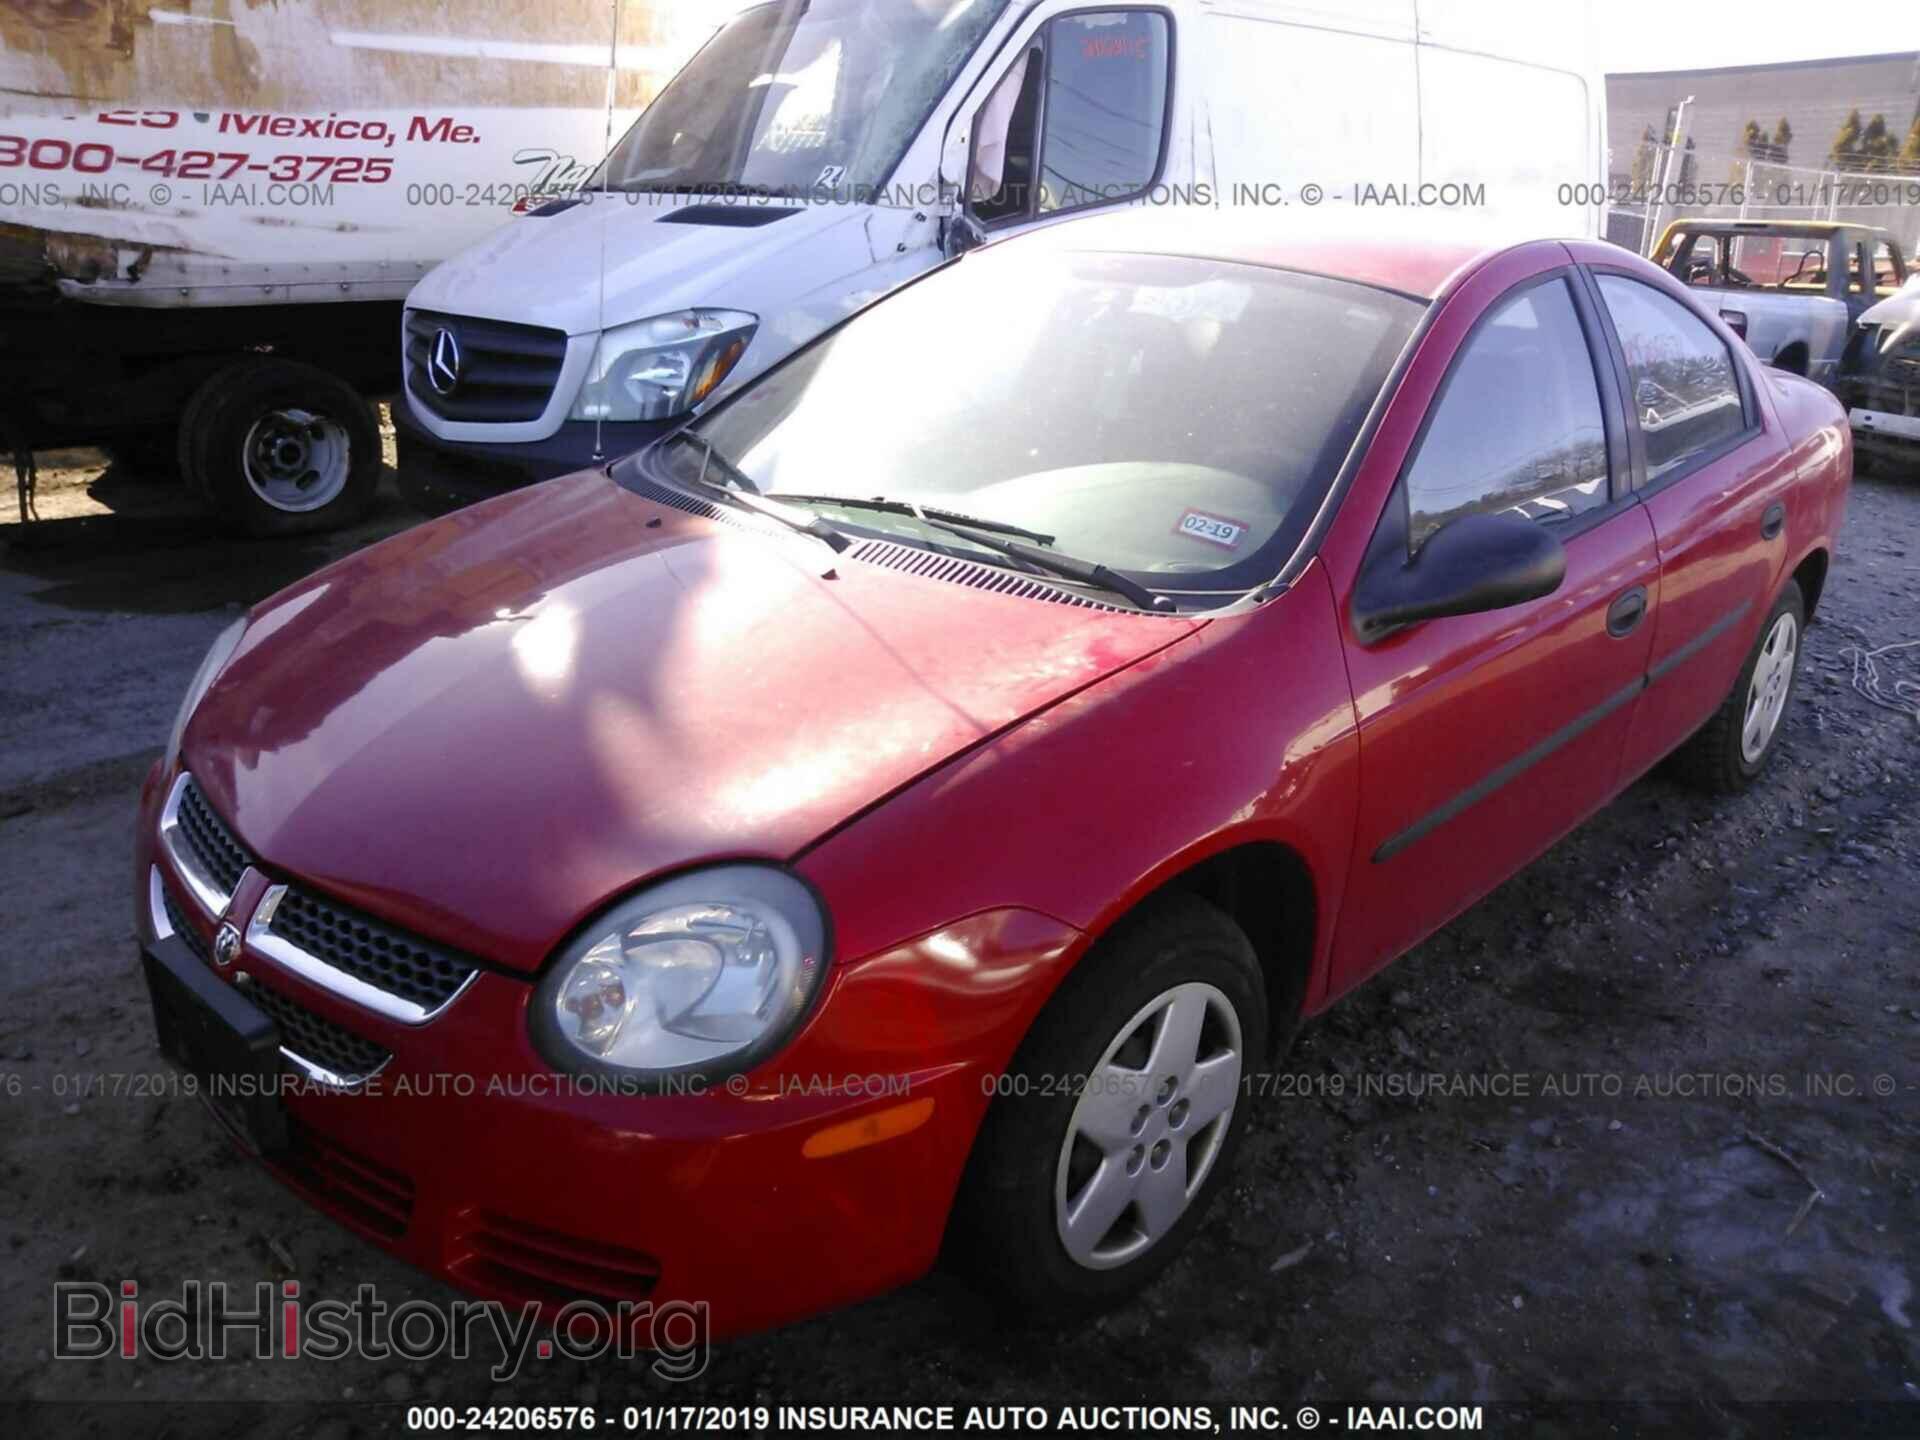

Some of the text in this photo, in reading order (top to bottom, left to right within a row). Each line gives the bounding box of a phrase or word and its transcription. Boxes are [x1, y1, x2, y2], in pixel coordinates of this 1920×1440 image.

[218, 113, 395, 148] Mexico,
[407, 116, 481, 144] Me.
[1184, 517, 1233, 539] 02-19
